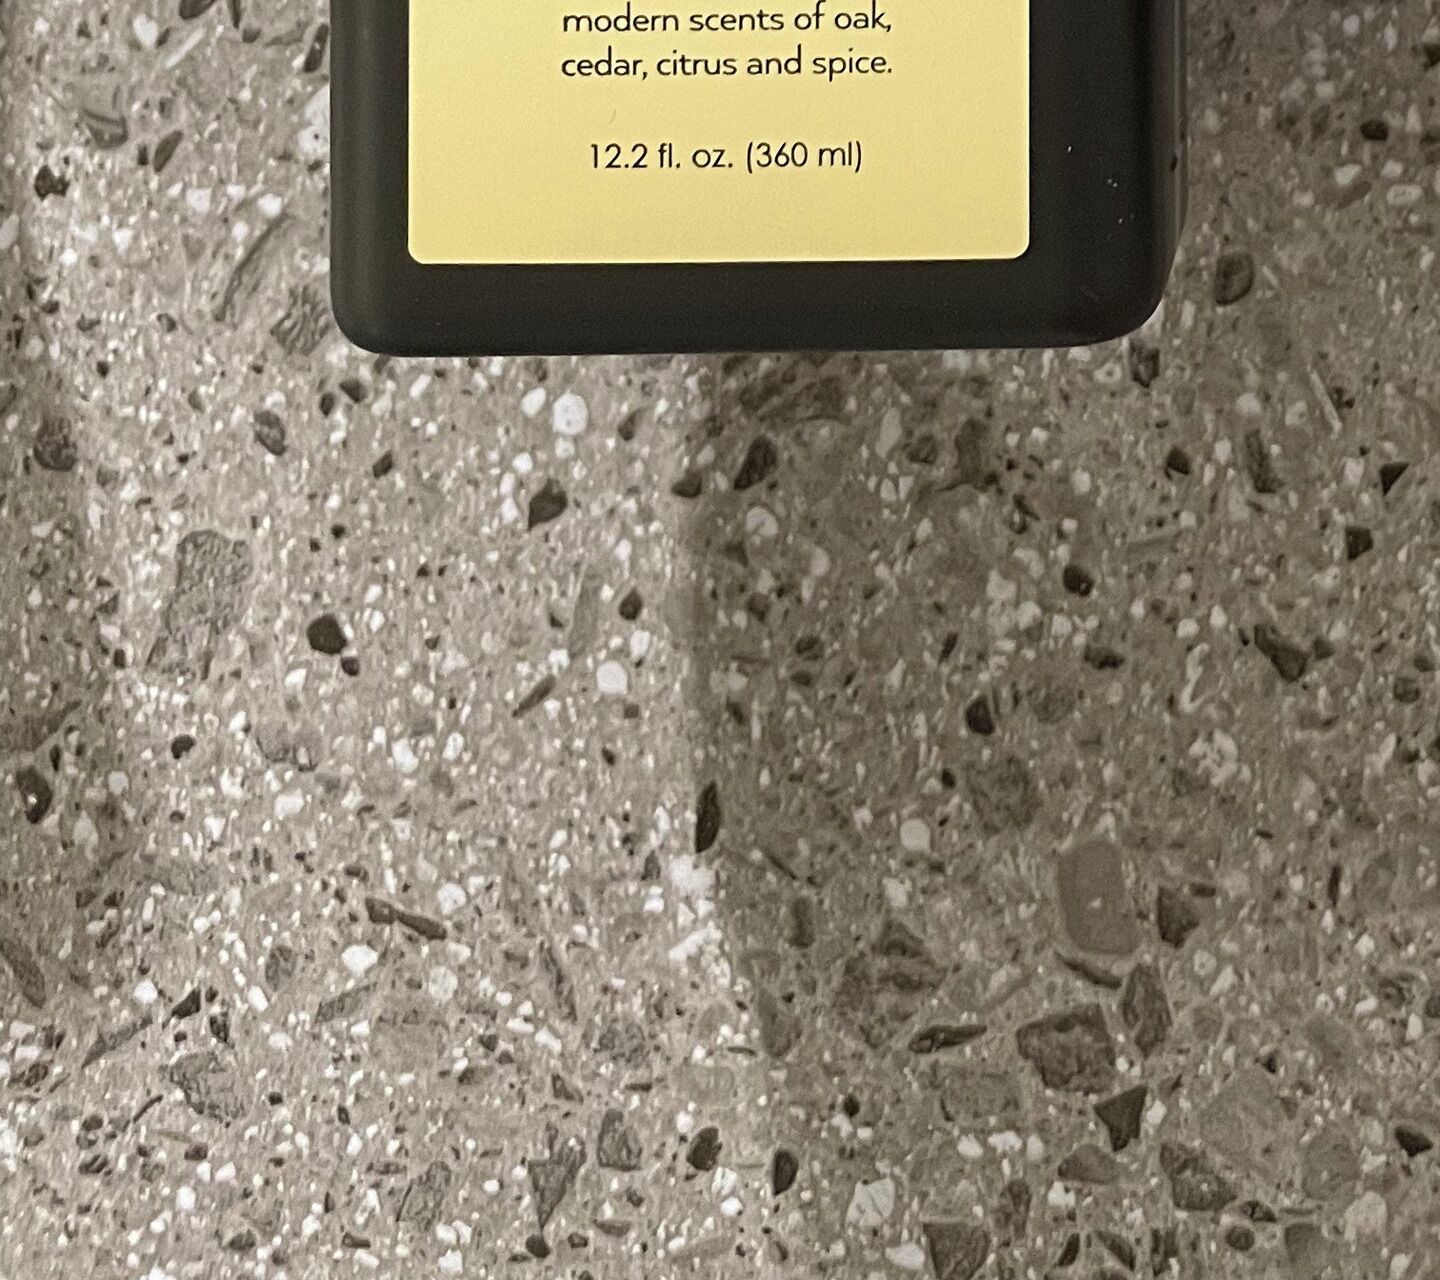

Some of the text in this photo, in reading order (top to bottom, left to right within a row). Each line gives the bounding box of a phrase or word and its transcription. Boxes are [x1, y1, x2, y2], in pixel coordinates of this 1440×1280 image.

[562, 0, 680, 33] modern
[689, 9, 785, 32] scents
[561, 43, 893, 83] cedar, citrus and spice.
[590, 140, 862, 175] 12.2 fl. oz. (360 ml)
